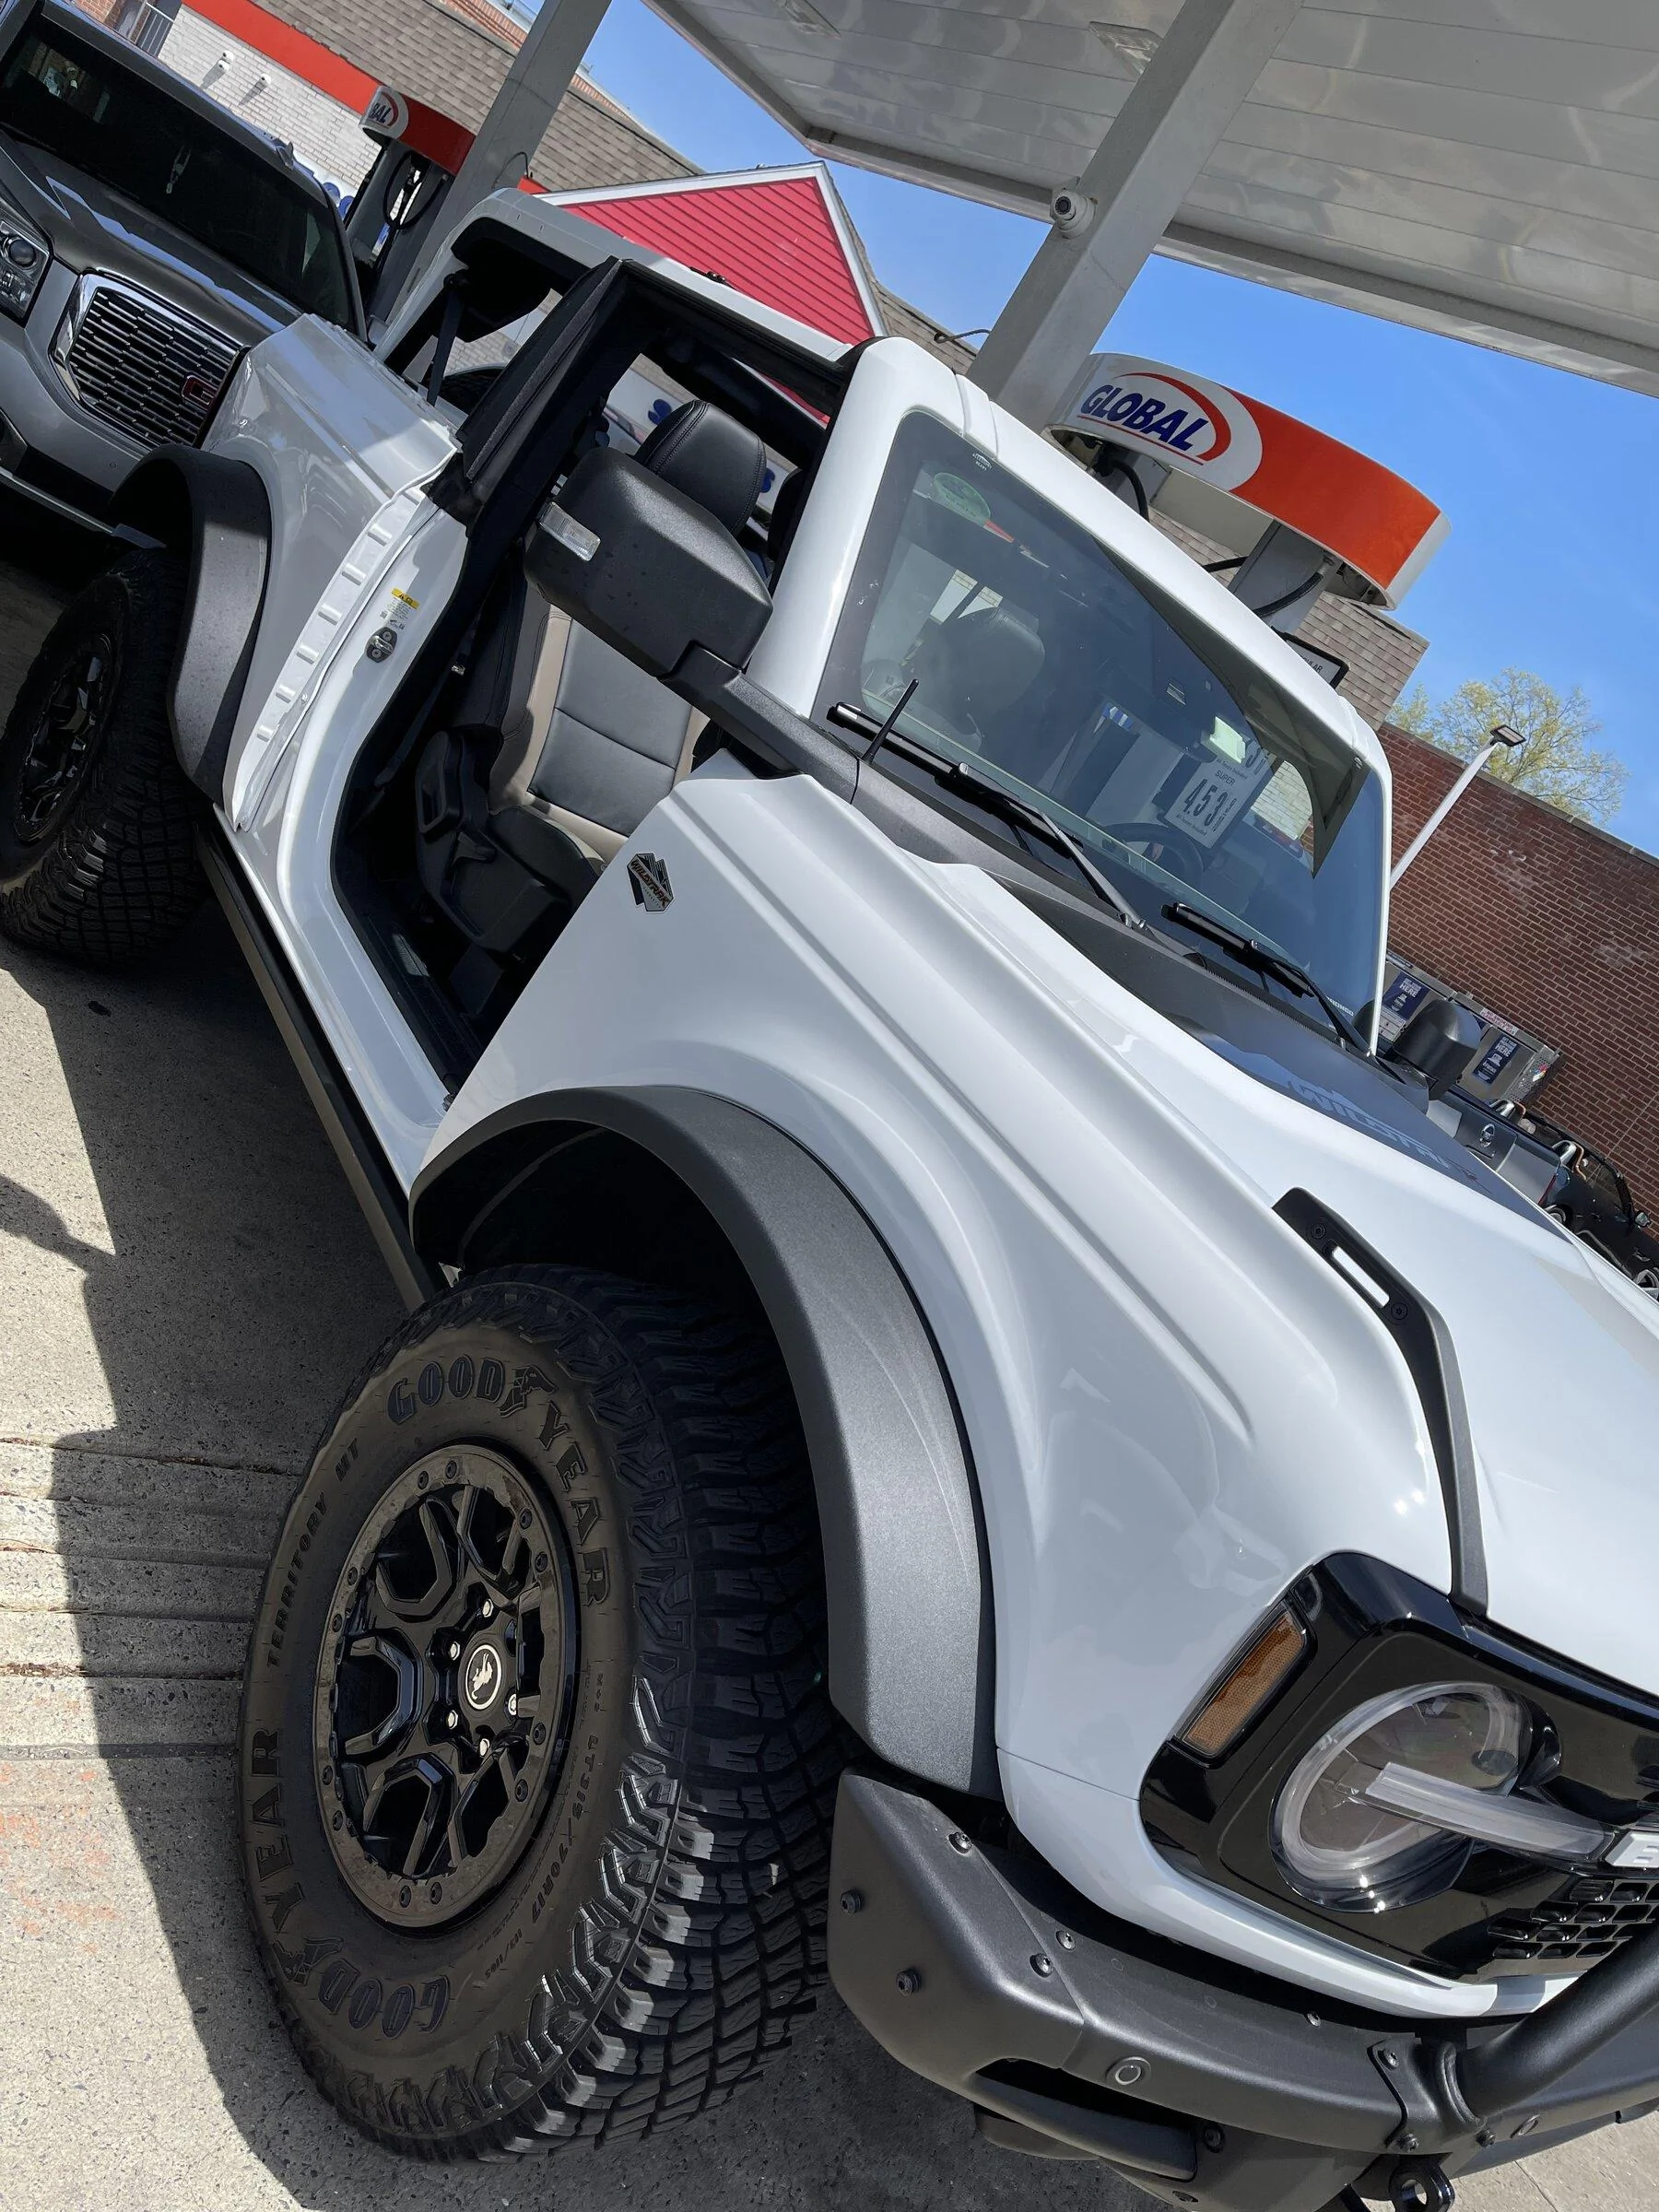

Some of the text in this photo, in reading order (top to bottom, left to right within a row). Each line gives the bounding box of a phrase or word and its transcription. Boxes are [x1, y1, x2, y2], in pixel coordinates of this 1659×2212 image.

[1080, 384, 1209, 452] GLOBAL
[1215, 770, 1236, 786] SUPER
[630, 860, 670, 908] WILDTRAK
[1400, 983, 1418, 997] HERE
[1495, 1042, 1512, 1057] HERE
[387, 1354, 610, 1606] GOODYEAR
[265, 1437, 361, 1668] TERRITORY MT
[251, 1728, 451, 2039] GOODYEAR
